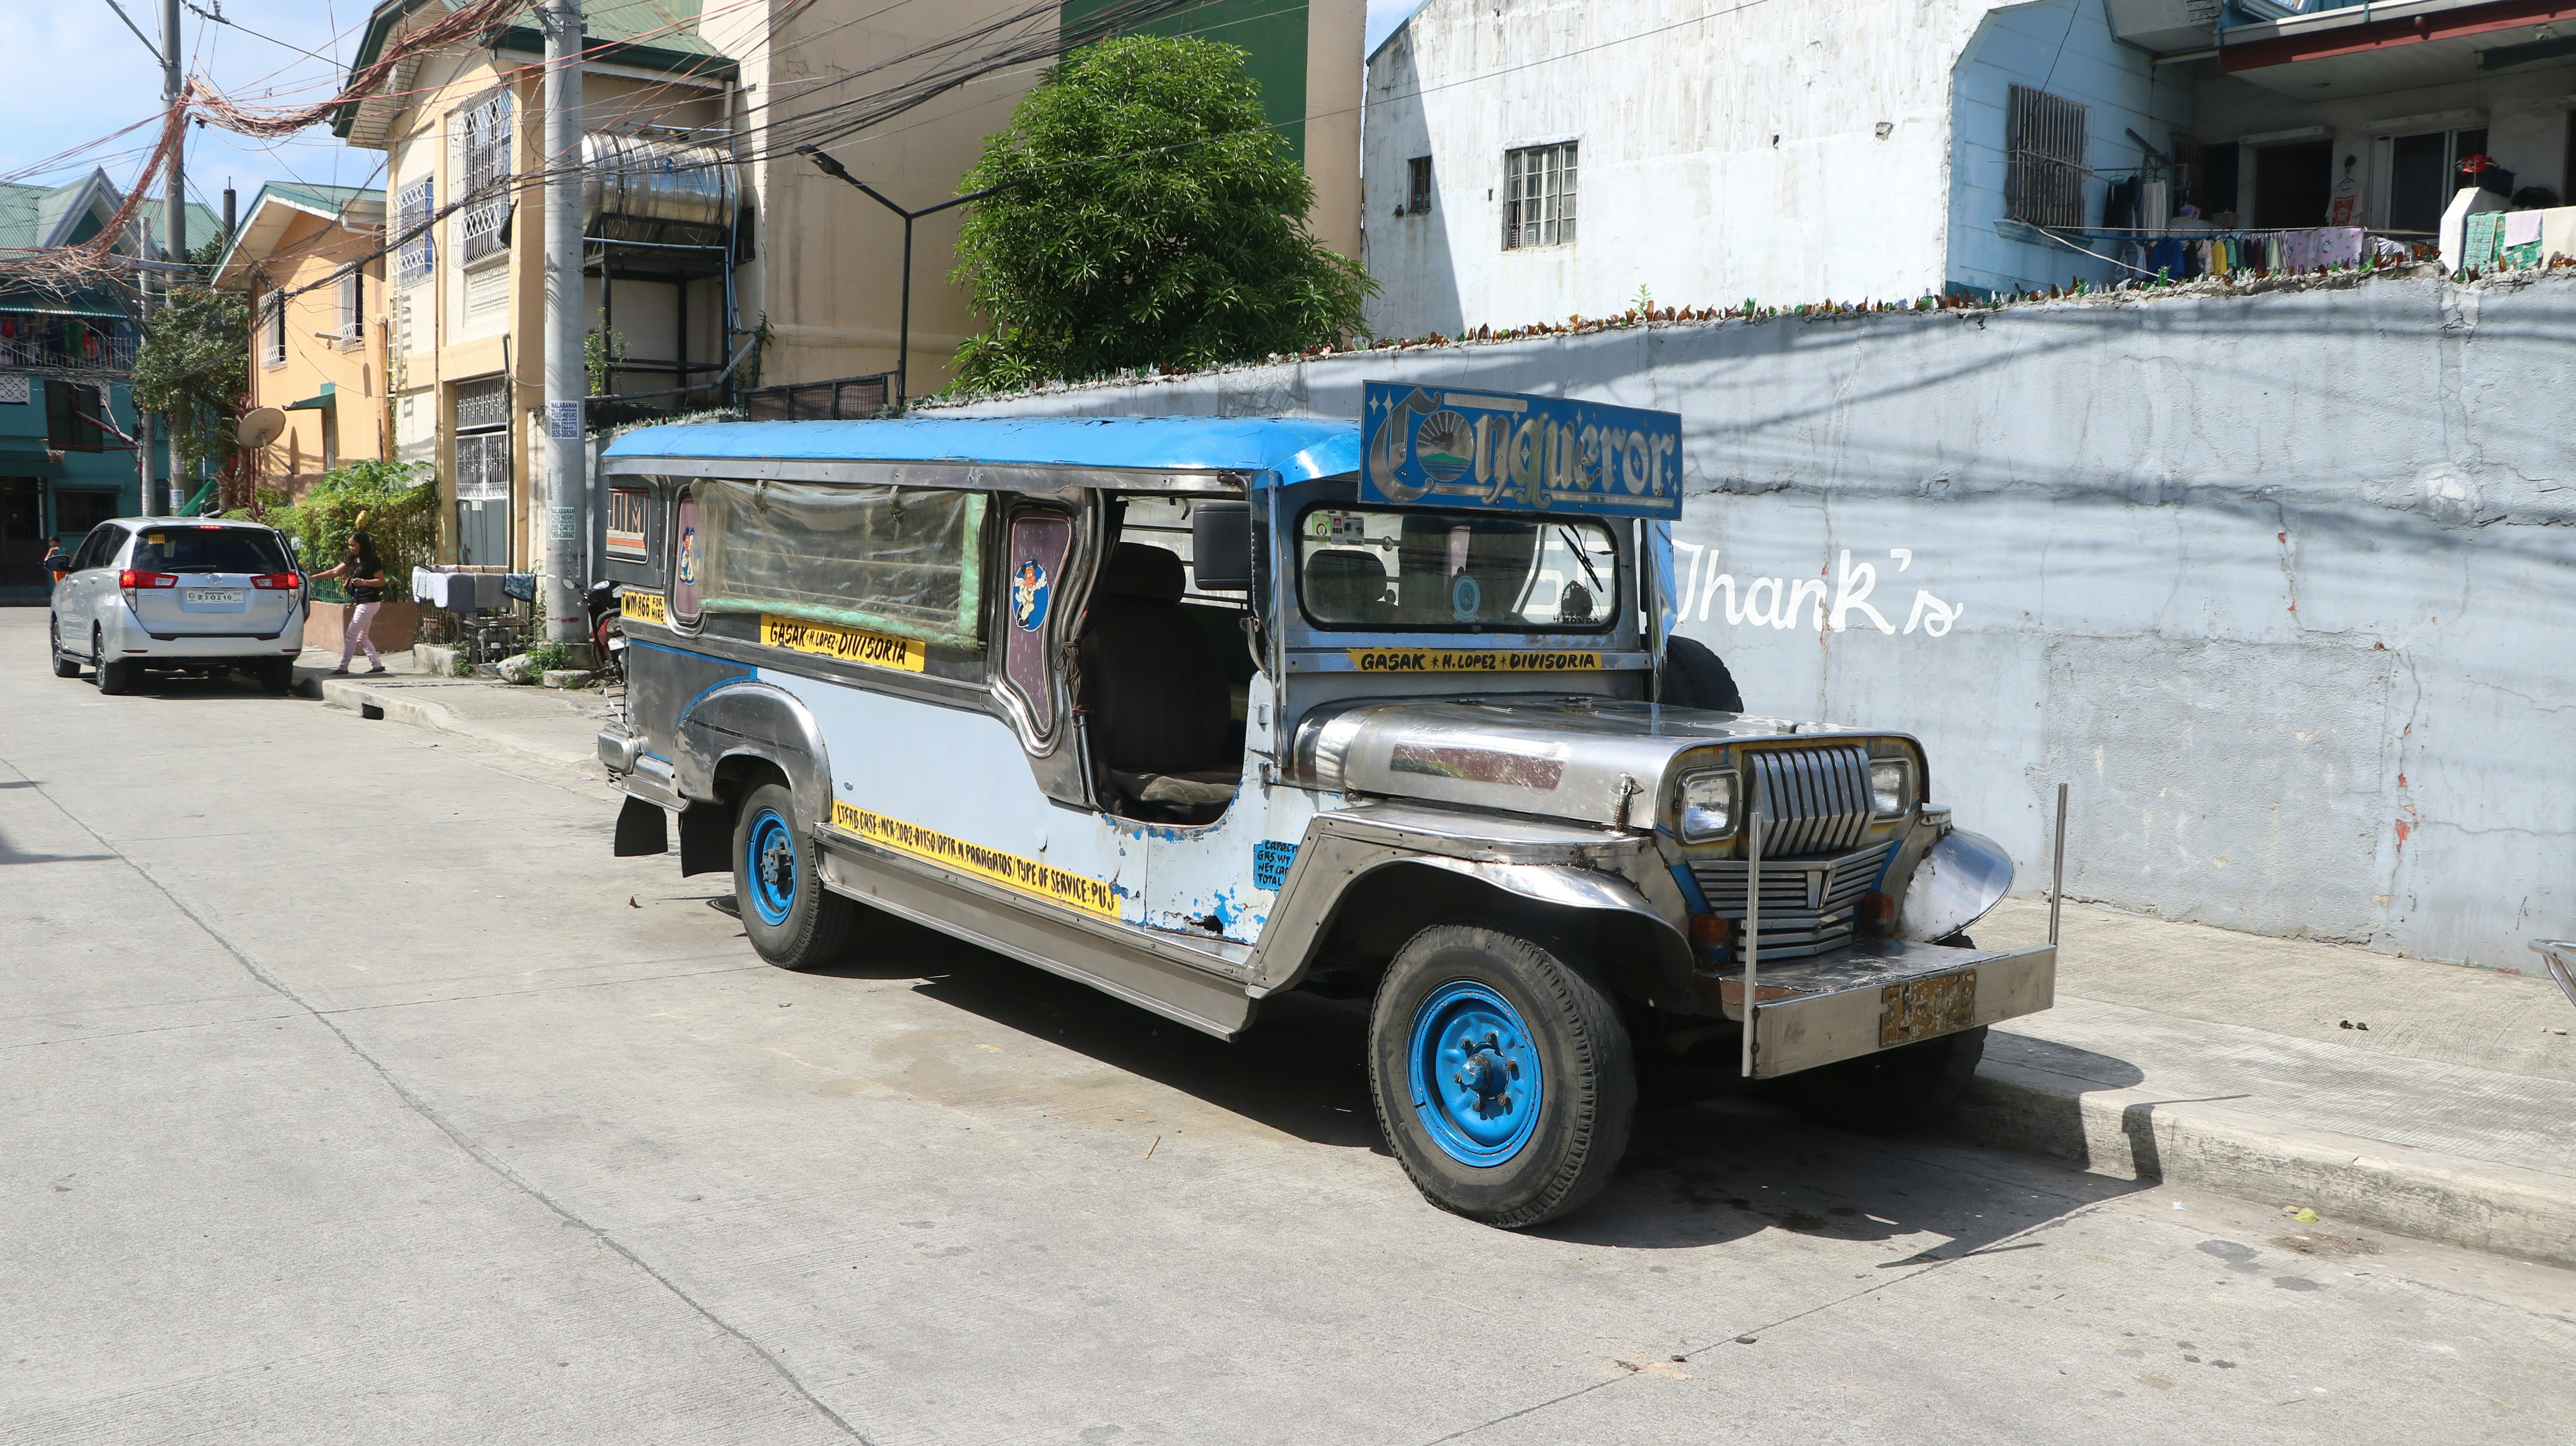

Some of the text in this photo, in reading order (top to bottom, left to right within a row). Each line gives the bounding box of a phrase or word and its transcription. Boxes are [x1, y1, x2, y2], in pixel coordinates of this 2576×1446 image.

[653, 597, 662, 608] FOR
[652, 608, 664, 622] HIRE
[770, 621, 808, 647] GASAK
[838, 632, 907, 665] DIVISORIA
[1361, 653, 1426, 671] GASAK
[1510, 653, 1596, 670] DIVISORIA
[837, 804, 859, 830] LTFRB
[860, 811, 877, 835] CASE
[1039, 866, 1048, 890] OF
[1258, 862, 1274, 874] NET
[1258, 873, 1282, 887] TOTAL
